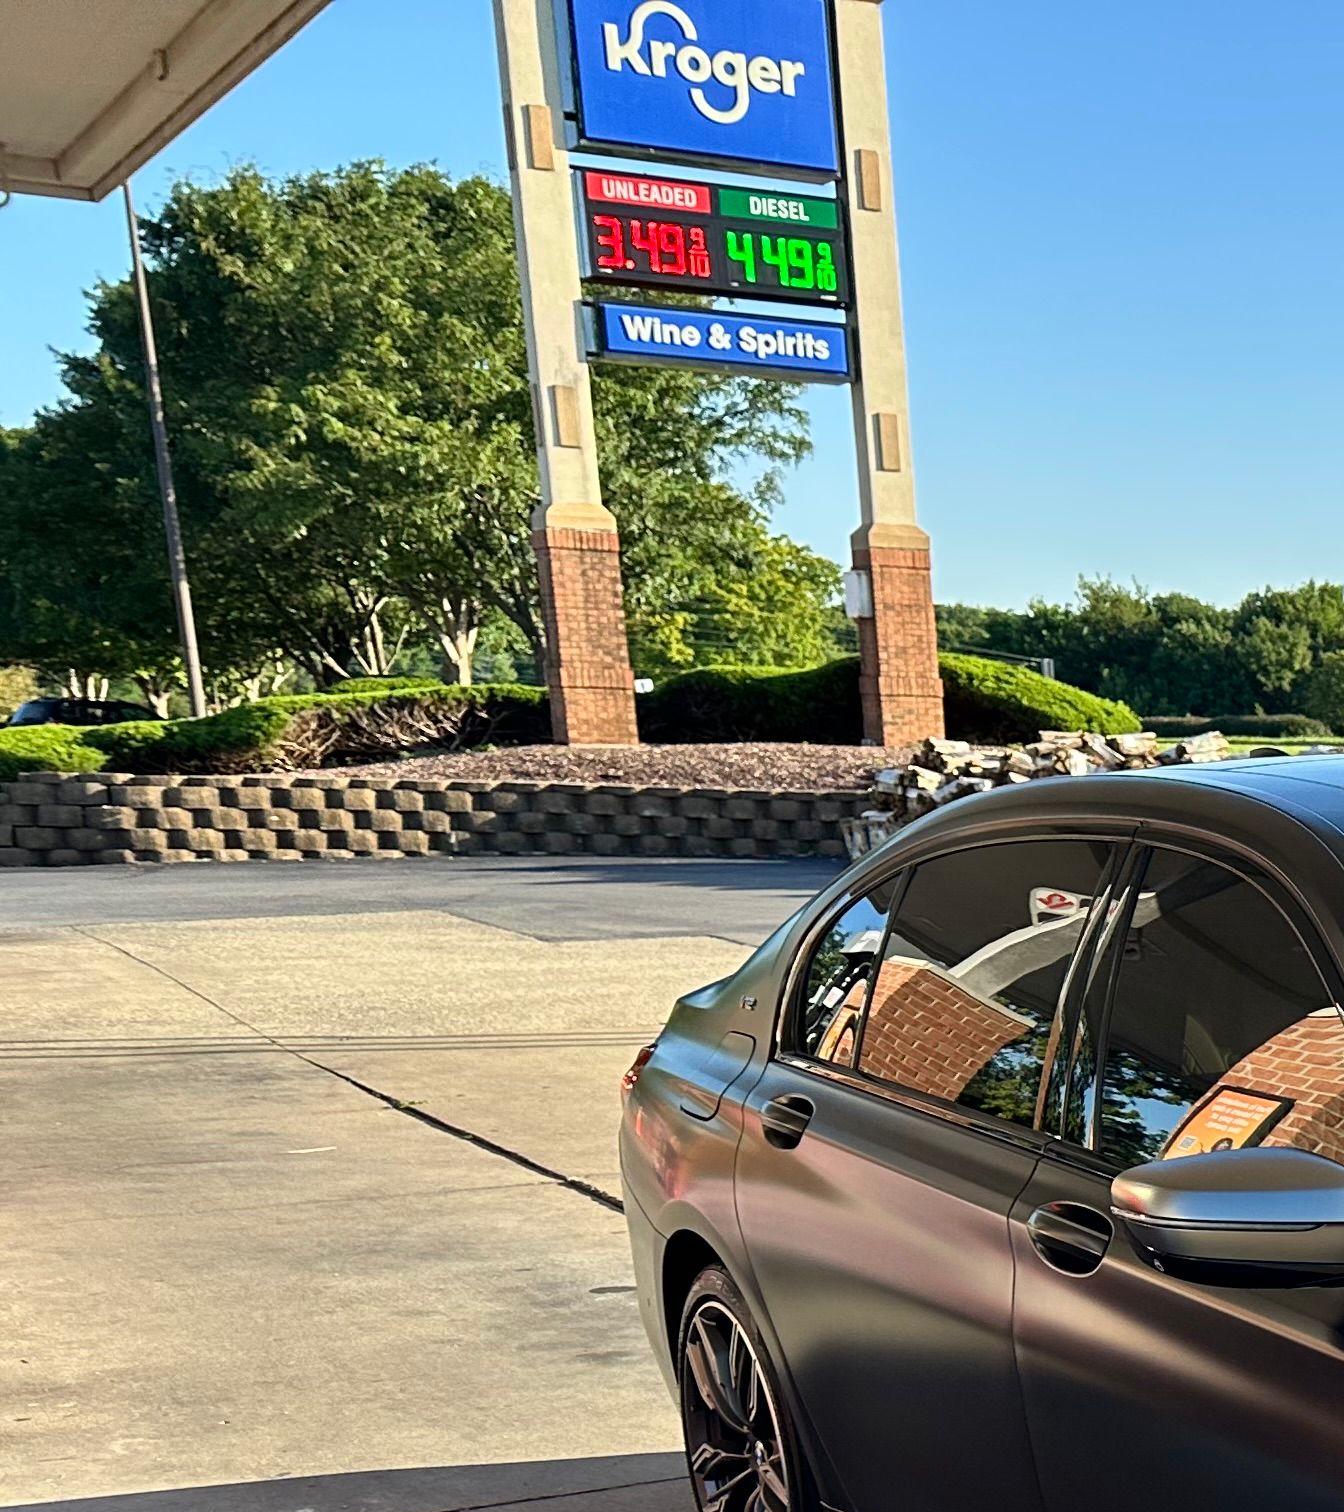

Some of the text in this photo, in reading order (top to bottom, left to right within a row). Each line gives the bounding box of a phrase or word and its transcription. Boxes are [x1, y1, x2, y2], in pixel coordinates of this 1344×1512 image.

[603, 0, 805, 124] Kroger
[602, 178, 697, 208] UNLEADED
[749, 195, 810, 222] DIESEL
[621, 314, 831, 361] Wine & Spirits
